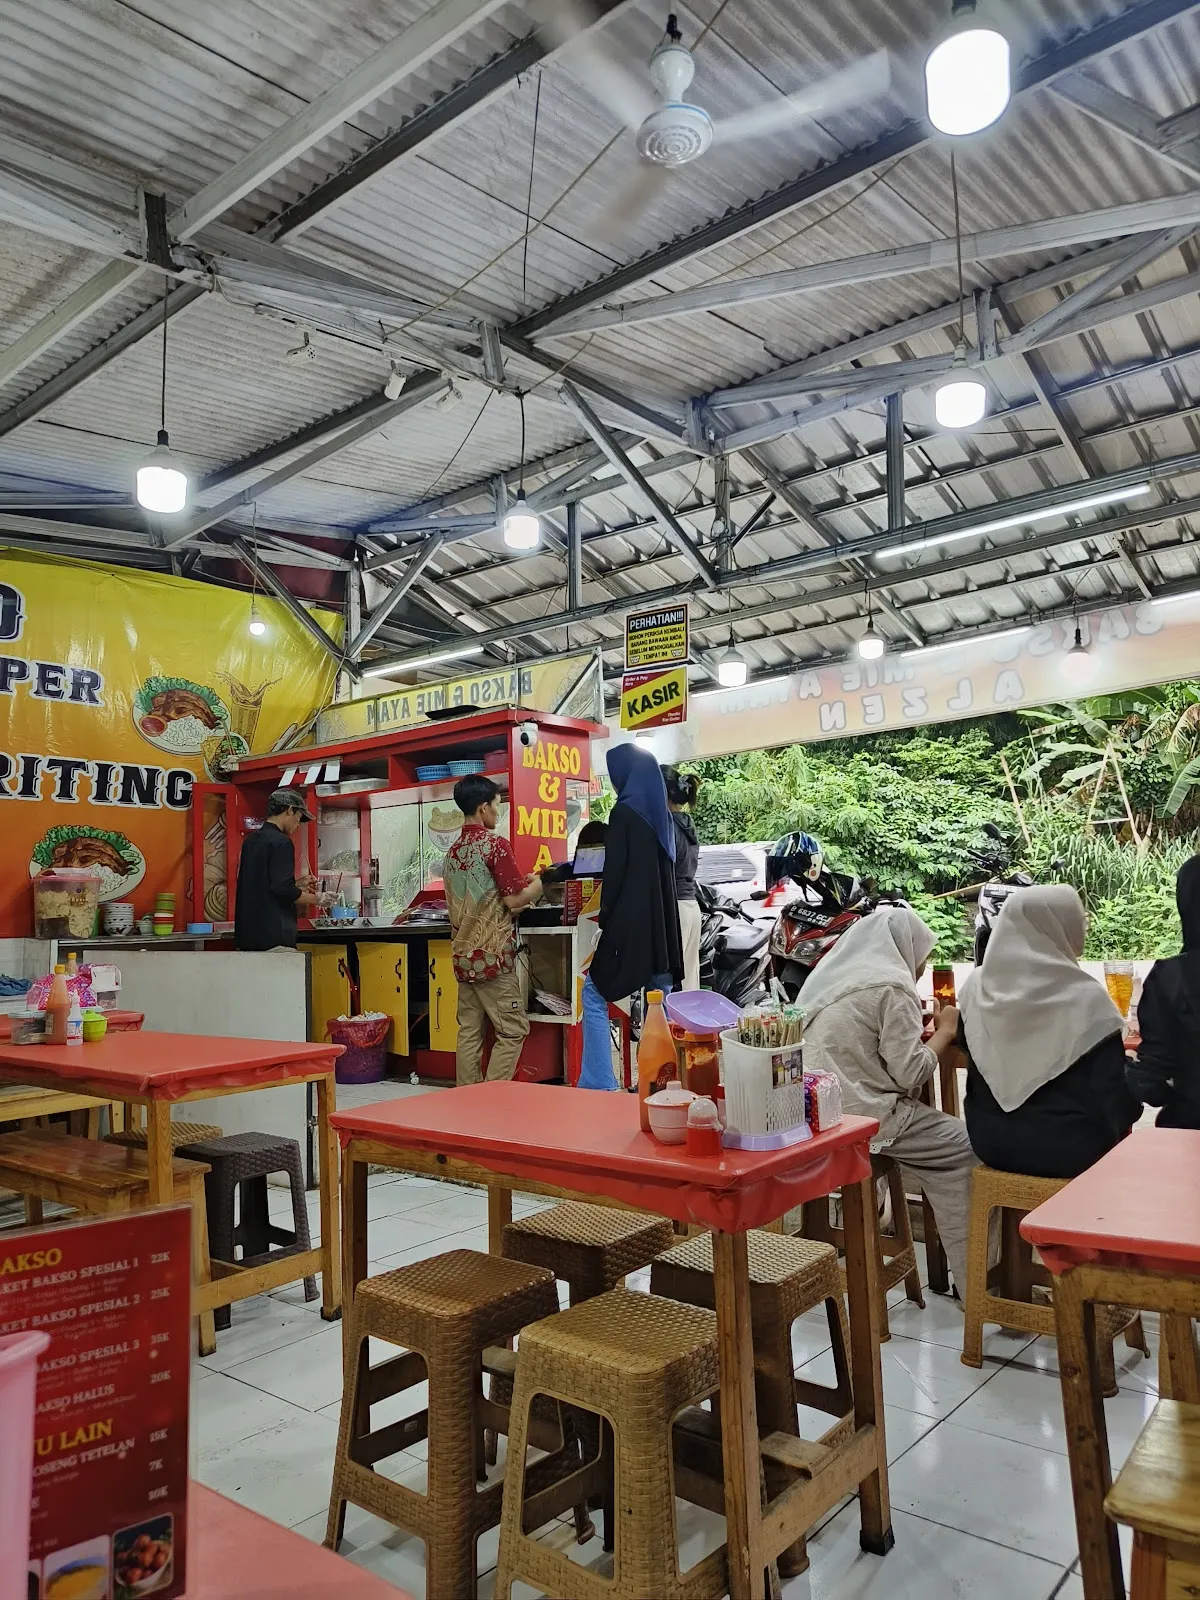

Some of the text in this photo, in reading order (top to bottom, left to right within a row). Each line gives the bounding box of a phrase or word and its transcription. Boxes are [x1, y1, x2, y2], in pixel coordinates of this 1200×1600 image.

[630, 610, 684, 630] PERHATIAN!!!
[0, 655, 105, 707] PER
[626, 681, 681, 718] KASIR
[522, 740, 581, 775] BAKSO
[538, 772, 560, 803] &
[517, 806, 568, 839] MIE
[0, 1251, 171, 1295] KET BAKSO SPESIAL 1 22K
[0, 1318, 30, 1333] KET
[32, 1307, 77, 1327] BAKSO
[79, 1295, 131, 1316] SPESIAL
[133, 1294, 141, 1304] 2
[150, 1287, 170, 1300] 25K
[38, 1355, 78, 1372] AKSO
[78, 1343, 130, 1363] SPESIAL
[35, 1418, 114, 1456] U LAIN
[79, 1438, 136, 1464] TETELAN
